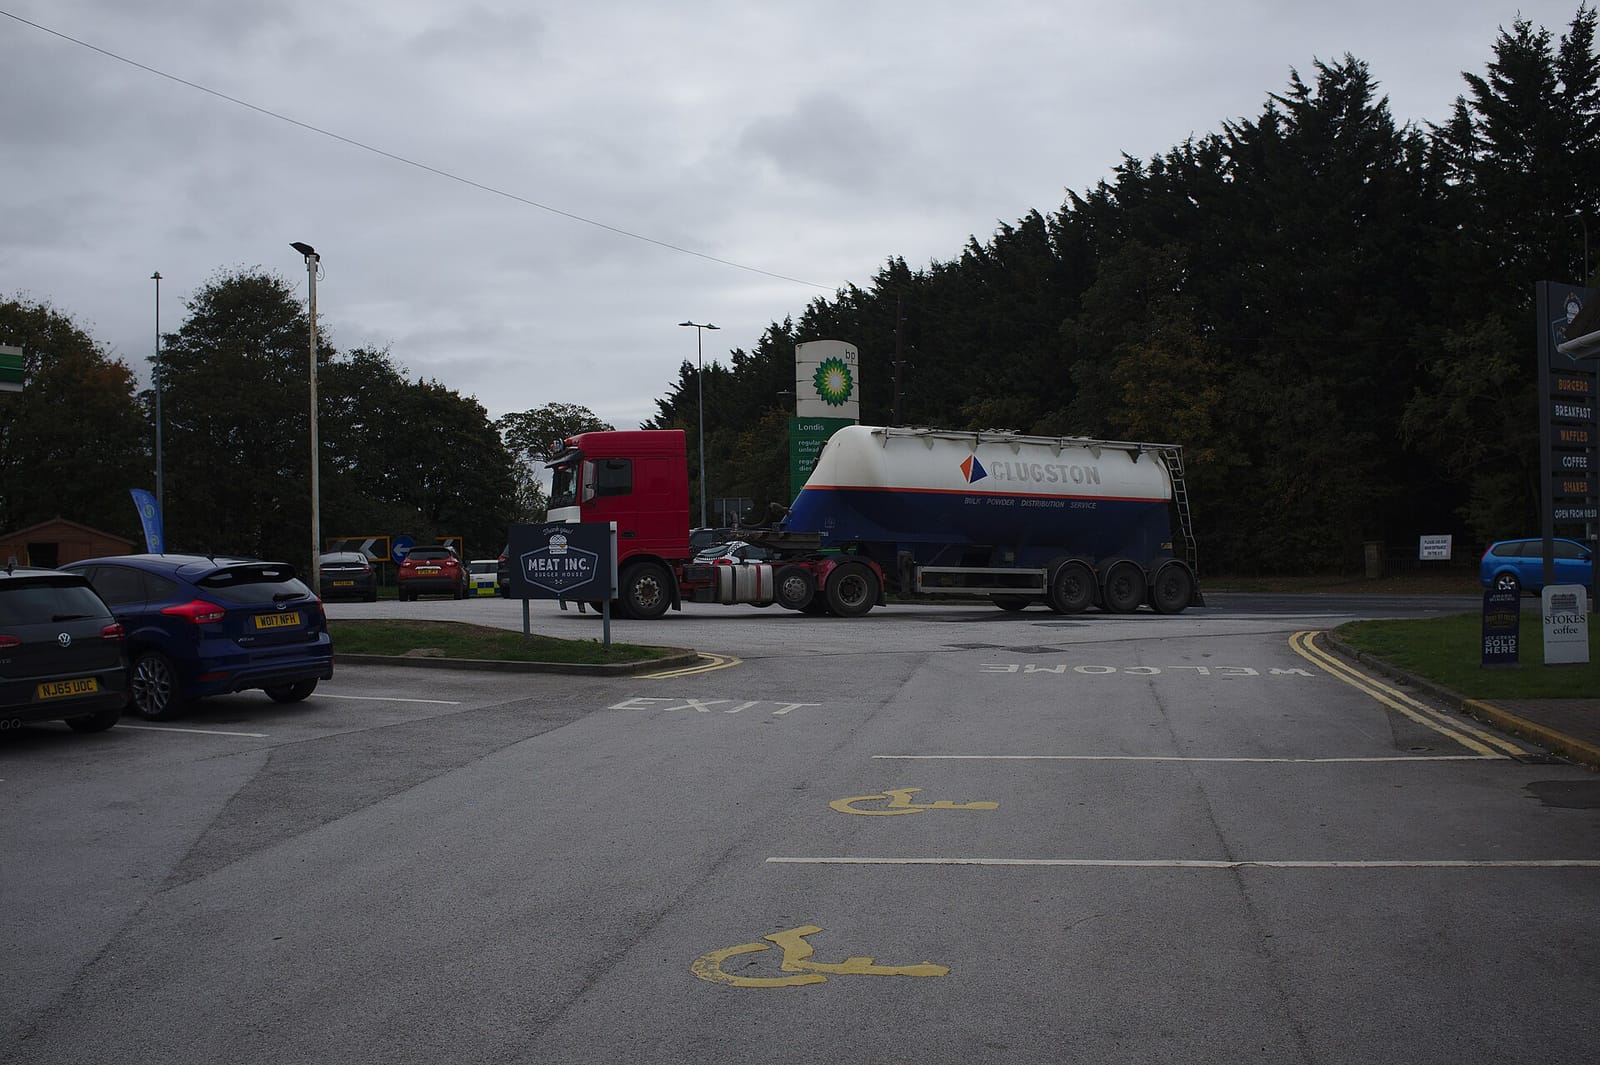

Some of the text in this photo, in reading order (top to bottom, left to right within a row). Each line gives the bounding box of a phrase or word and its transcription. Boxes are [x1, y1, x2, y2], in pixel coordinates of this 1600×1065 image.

[845, 349, 856, 364] bp
[1555, 404, 1591, 418] BREAKFAST
[798, 423, 824, 431] Londis
[1562, 456, 1587, 468] COFFEE
[991, 461, 1101, 485] CLUGSTON
[985, 498, 1016, 506] POWDER
[1020, 499, 1065, 508] DISTRIBUTION
[1069, 501, 1097, 509] SERVICE
[1554, 508, 1569, 519] OPEN
[528, 558, 590, 571] MEAT INC.
[1544, 614, 1586, 625] STOKES
[1552, 625, 1579, 635] coffee
[1484, 646, 1517, 654] HERE
[979, 663, 1316, 677] WELCOME
[42, 680, 93, 696] NJ65 UOC
[608, 697, 822, 715] EXIT
